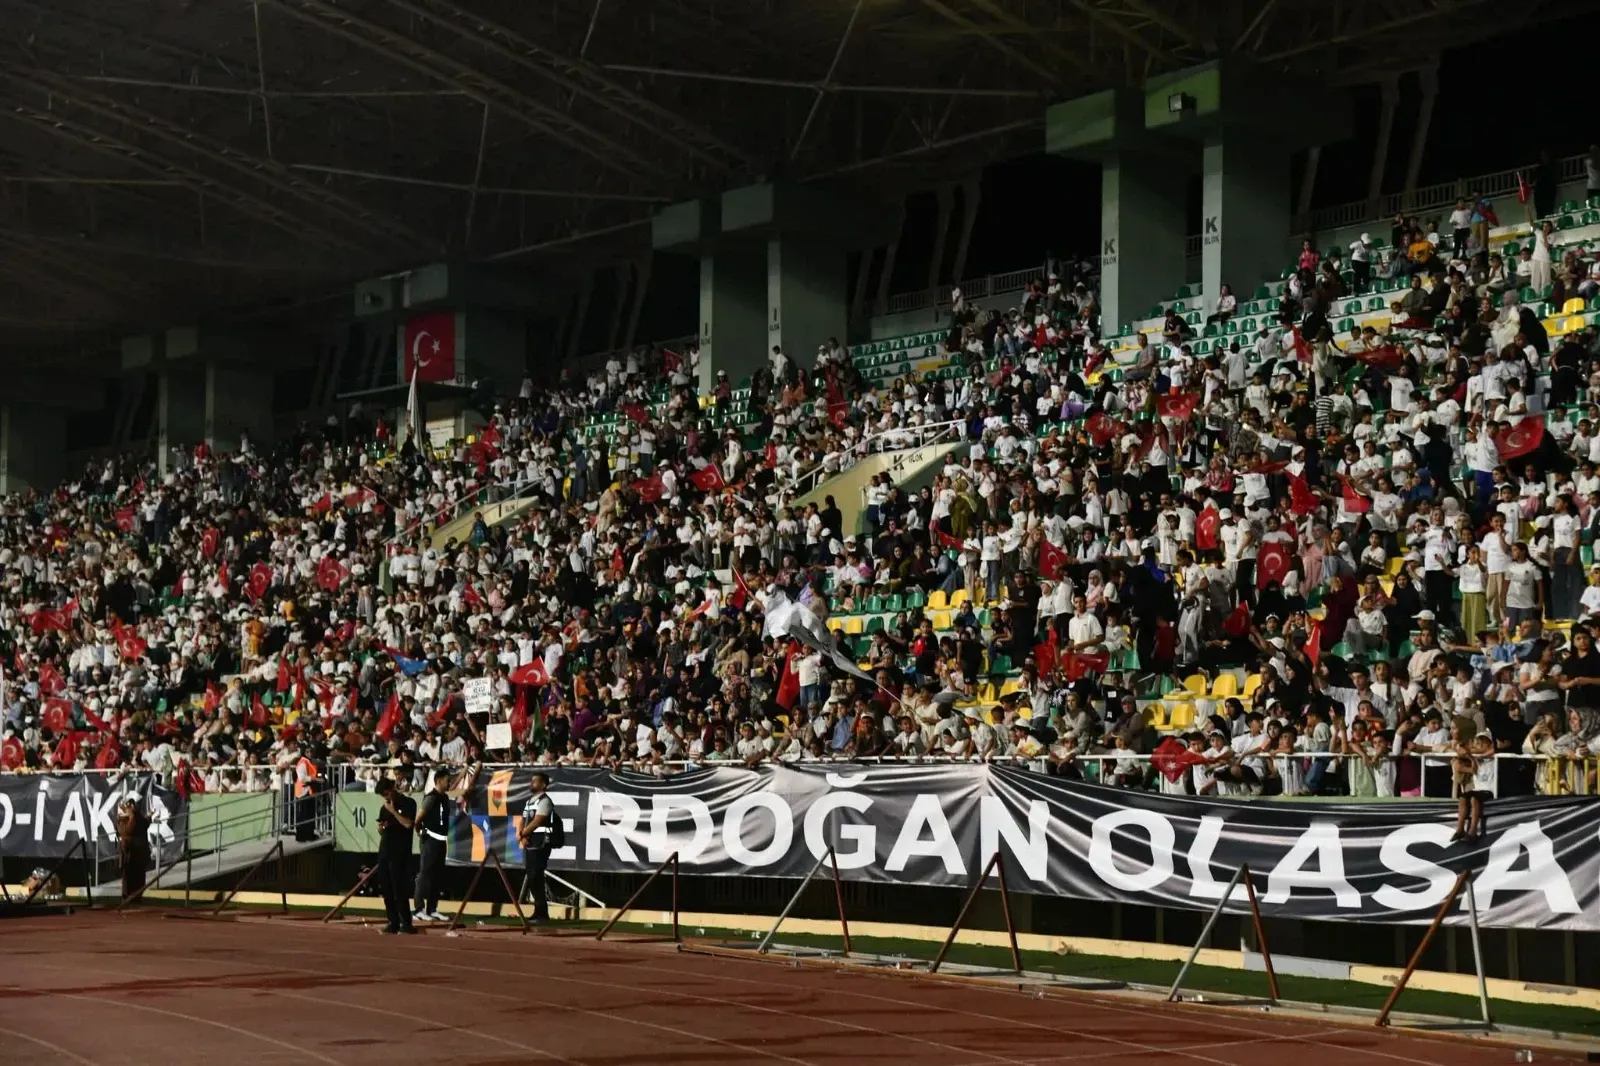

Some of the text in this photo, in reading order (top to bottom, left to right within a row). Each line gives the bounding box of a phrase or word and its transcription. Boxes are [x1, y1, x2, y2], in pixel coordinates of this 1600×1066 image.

[1205, 216, 1218, 234] K
[1104, 239, 1115, 255] K
[893, 454, 905, 470] K
[353, 806, 366, 828] 10
[546, 773, 1600, 914] ERDOĞAN OLASA
